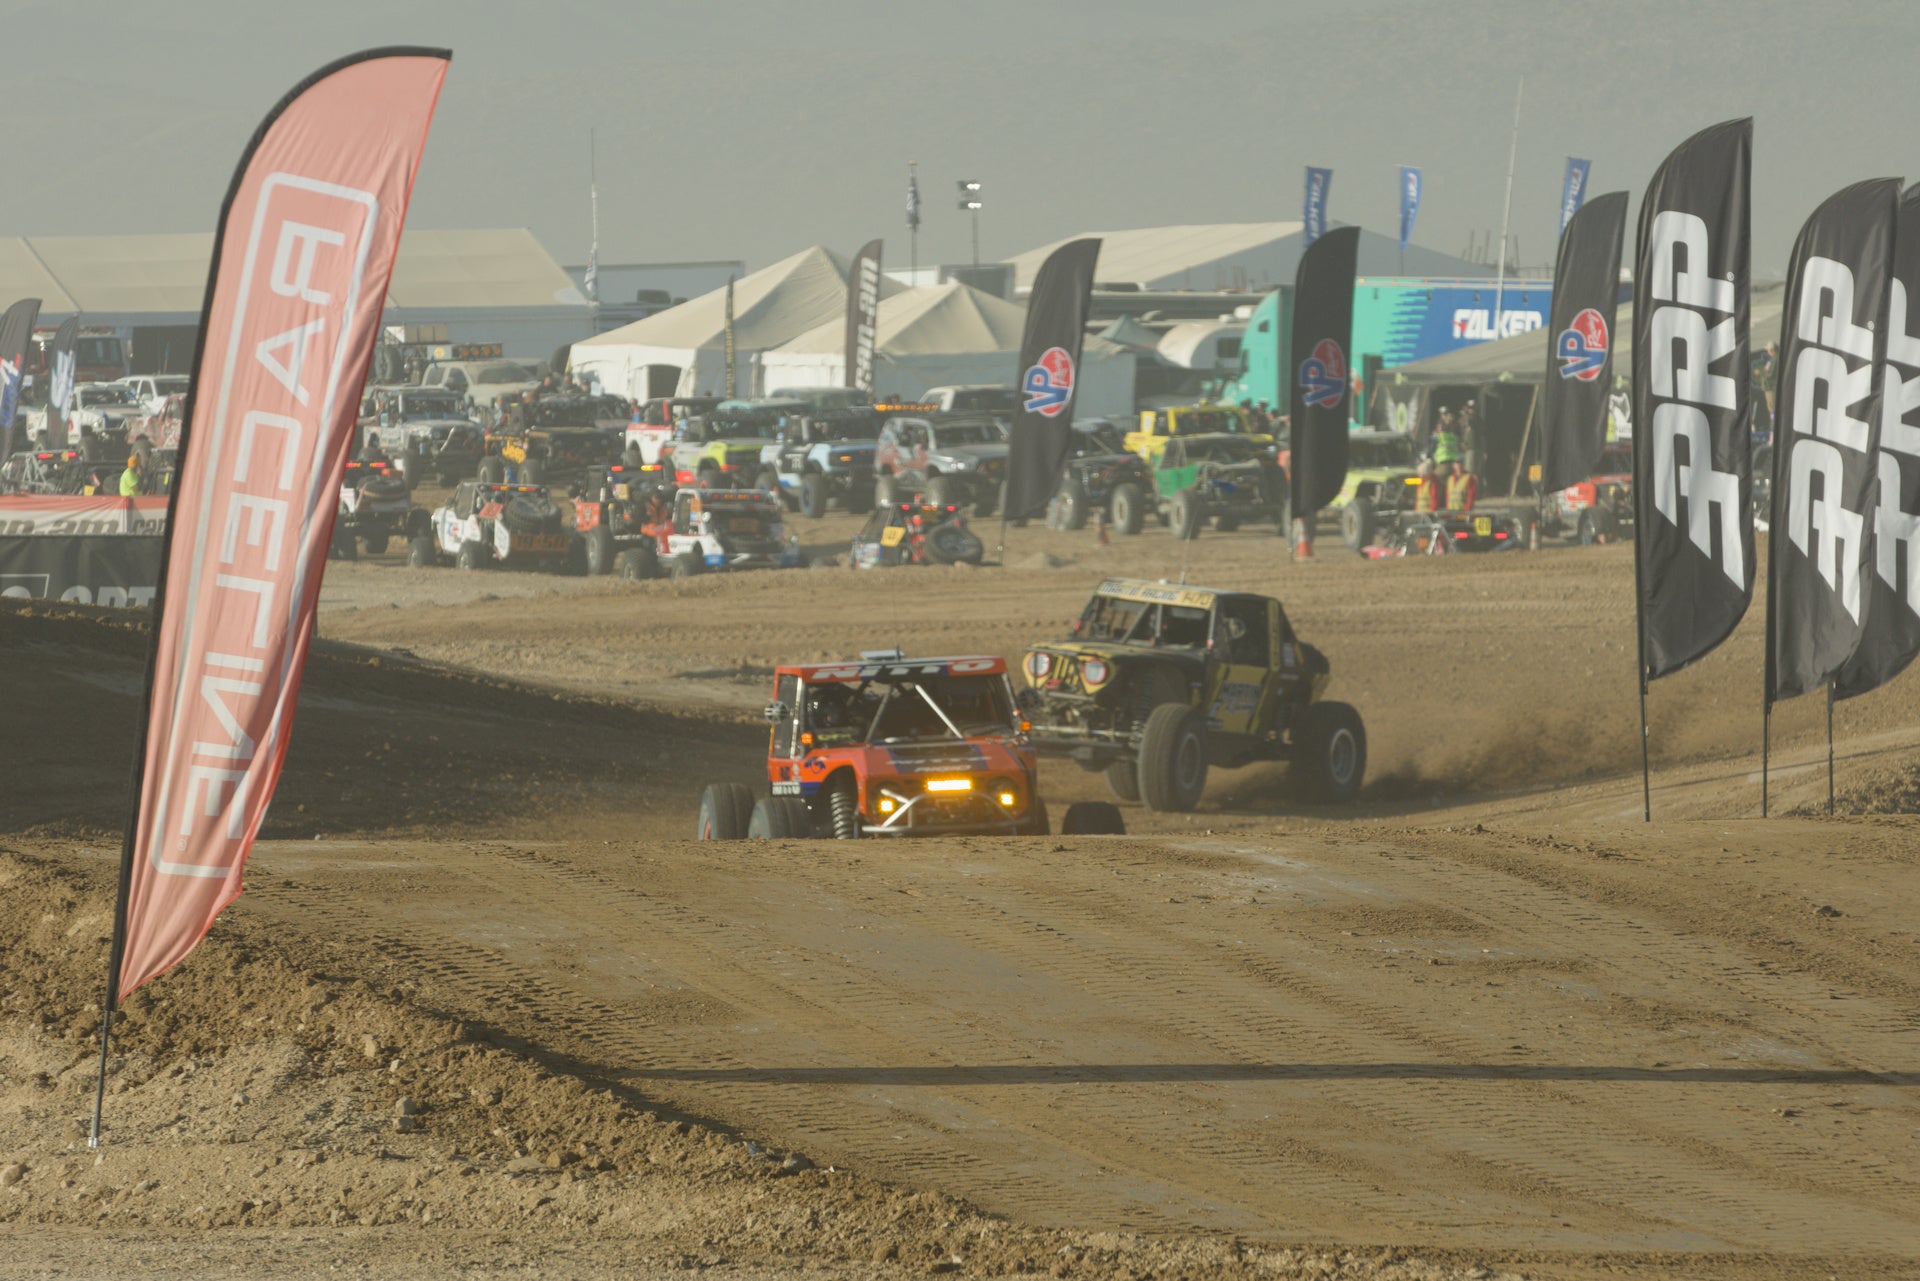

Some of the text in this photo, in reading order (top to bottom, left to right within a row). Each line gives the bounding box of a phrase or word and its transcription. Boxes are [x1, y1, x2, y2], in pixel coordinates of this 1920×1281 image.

[1557, 329, 1606, 378] VP
[1022, 365, 1068, 412] VP
[1300, 358, 1344, 406] VP
[1650, 211, 1745, 592] PRP
[1787, 256, 1873, 626] PRP
[812, 659, 996, 679] NITTO
